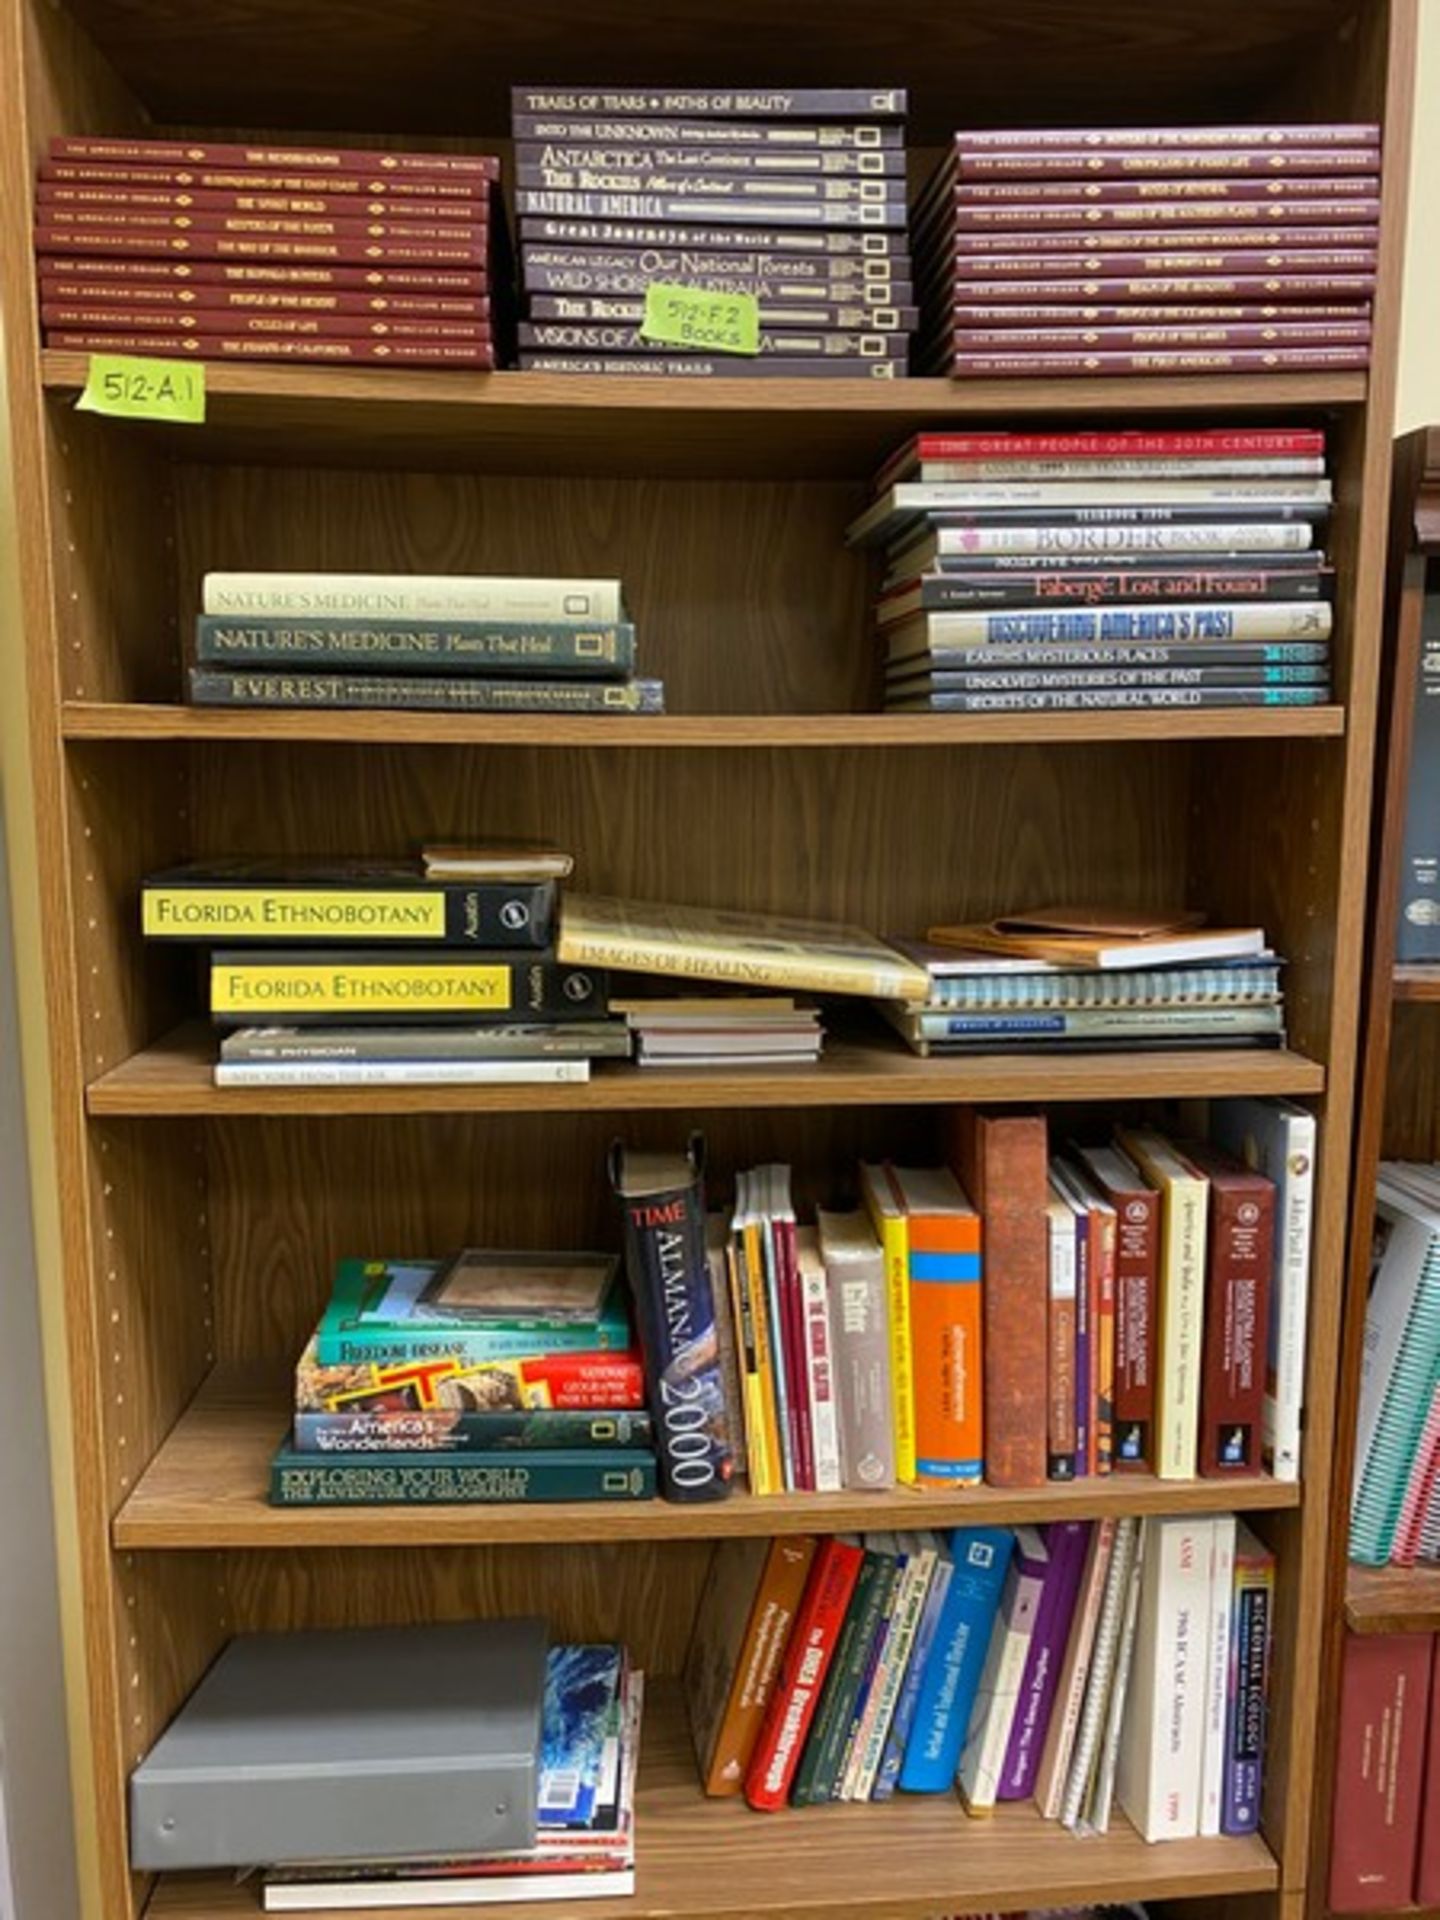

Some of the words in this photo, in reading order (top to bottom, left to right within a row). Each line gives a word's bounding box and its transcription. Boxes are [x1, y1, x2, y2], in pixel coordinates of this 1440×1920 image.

[640, 250, 678, 273] Our
[680, 251, 755, 275] National
[758, 254, 816, 277] Forests
[1221, 435, 1295, 450] CENTURY
[1193, 611, 1233, 639] PAST
[213, 629, 325, 649] NATURE'S
[328, 632, 439, 652] MEDICINE
[232, 677, 343, 699] EVEREST
[157, 898, 255, 924] FLORIDA
[263, 898, 433, 924] ETHNOBOTANY
[465, 892, 479, 938] Austin
[228, 975, 325, 998] FLORIDA
[333, 974, 497, 999] ETHNOBOTANY
[529, 965, 543, 1009] Austin
[630, 1202, 686, 1228] TIME
[656, 1229, 697, 1372] ALMANAC
[661, 1376, 715, 1488] 2000
[459, 1468, 529, 1485] WORLD
